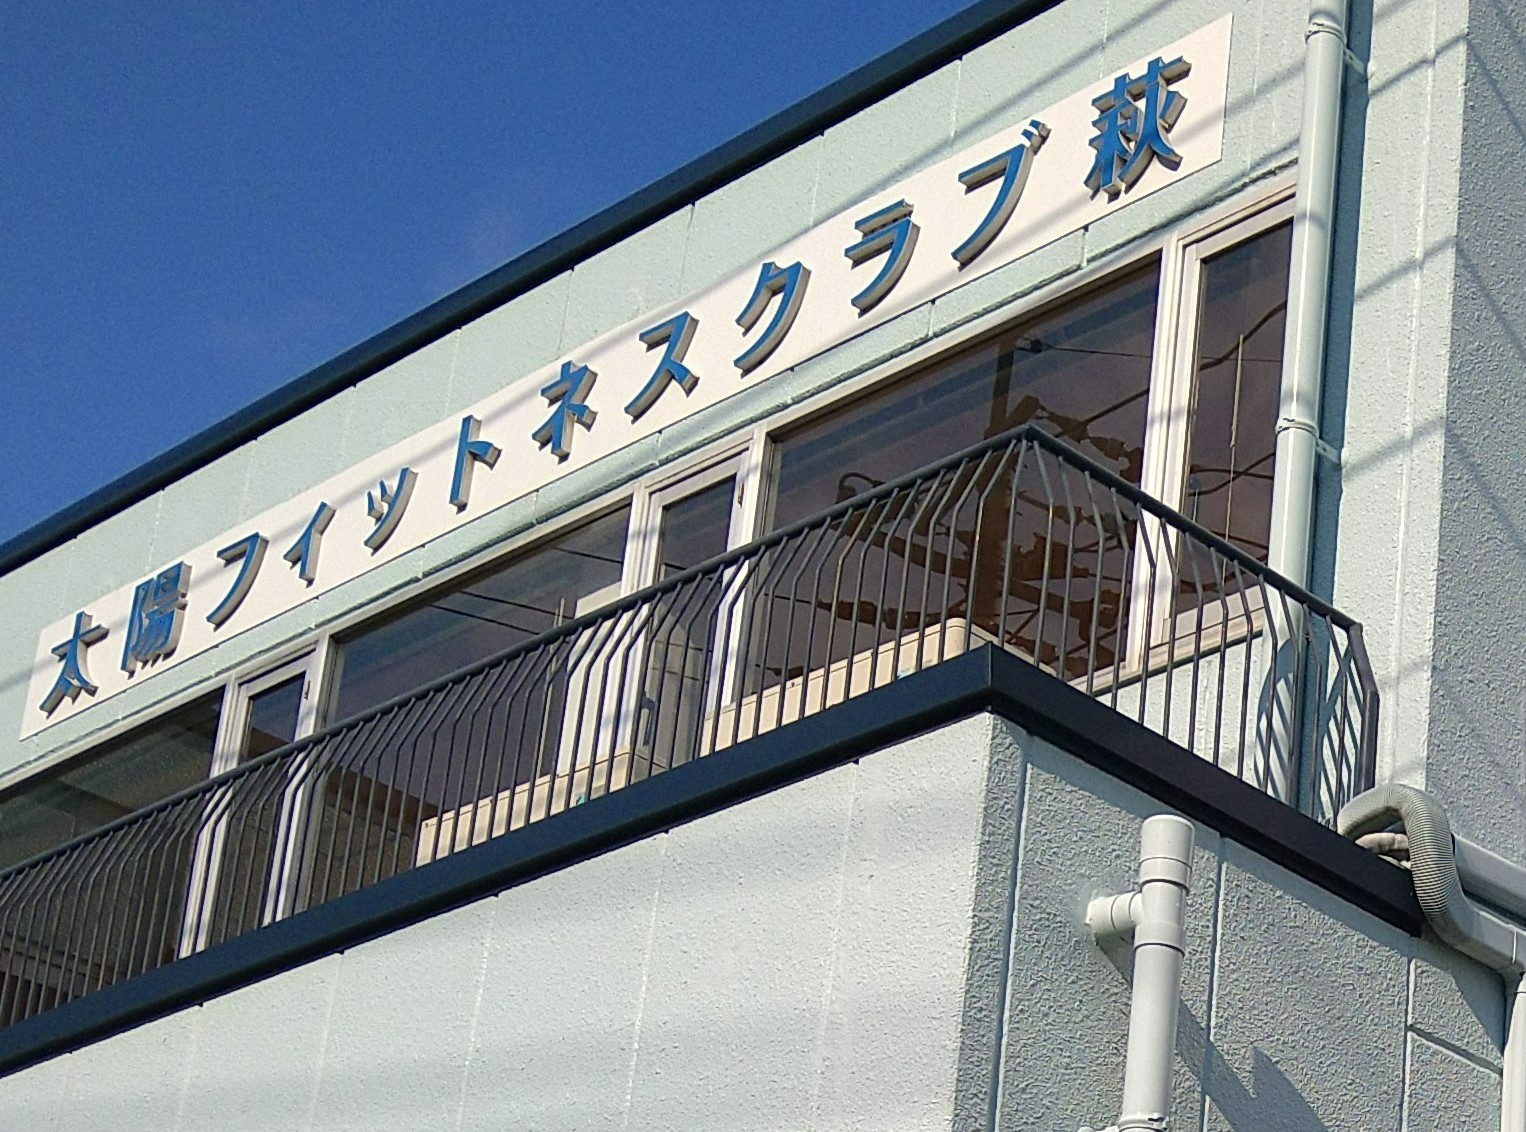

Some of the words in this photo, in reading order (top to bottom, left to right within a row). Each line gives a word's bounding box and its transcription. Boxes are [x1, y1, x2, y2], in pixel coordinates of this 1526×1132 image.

[38, 54, 1193, 718] 太陽フィットネスクラブ萩
